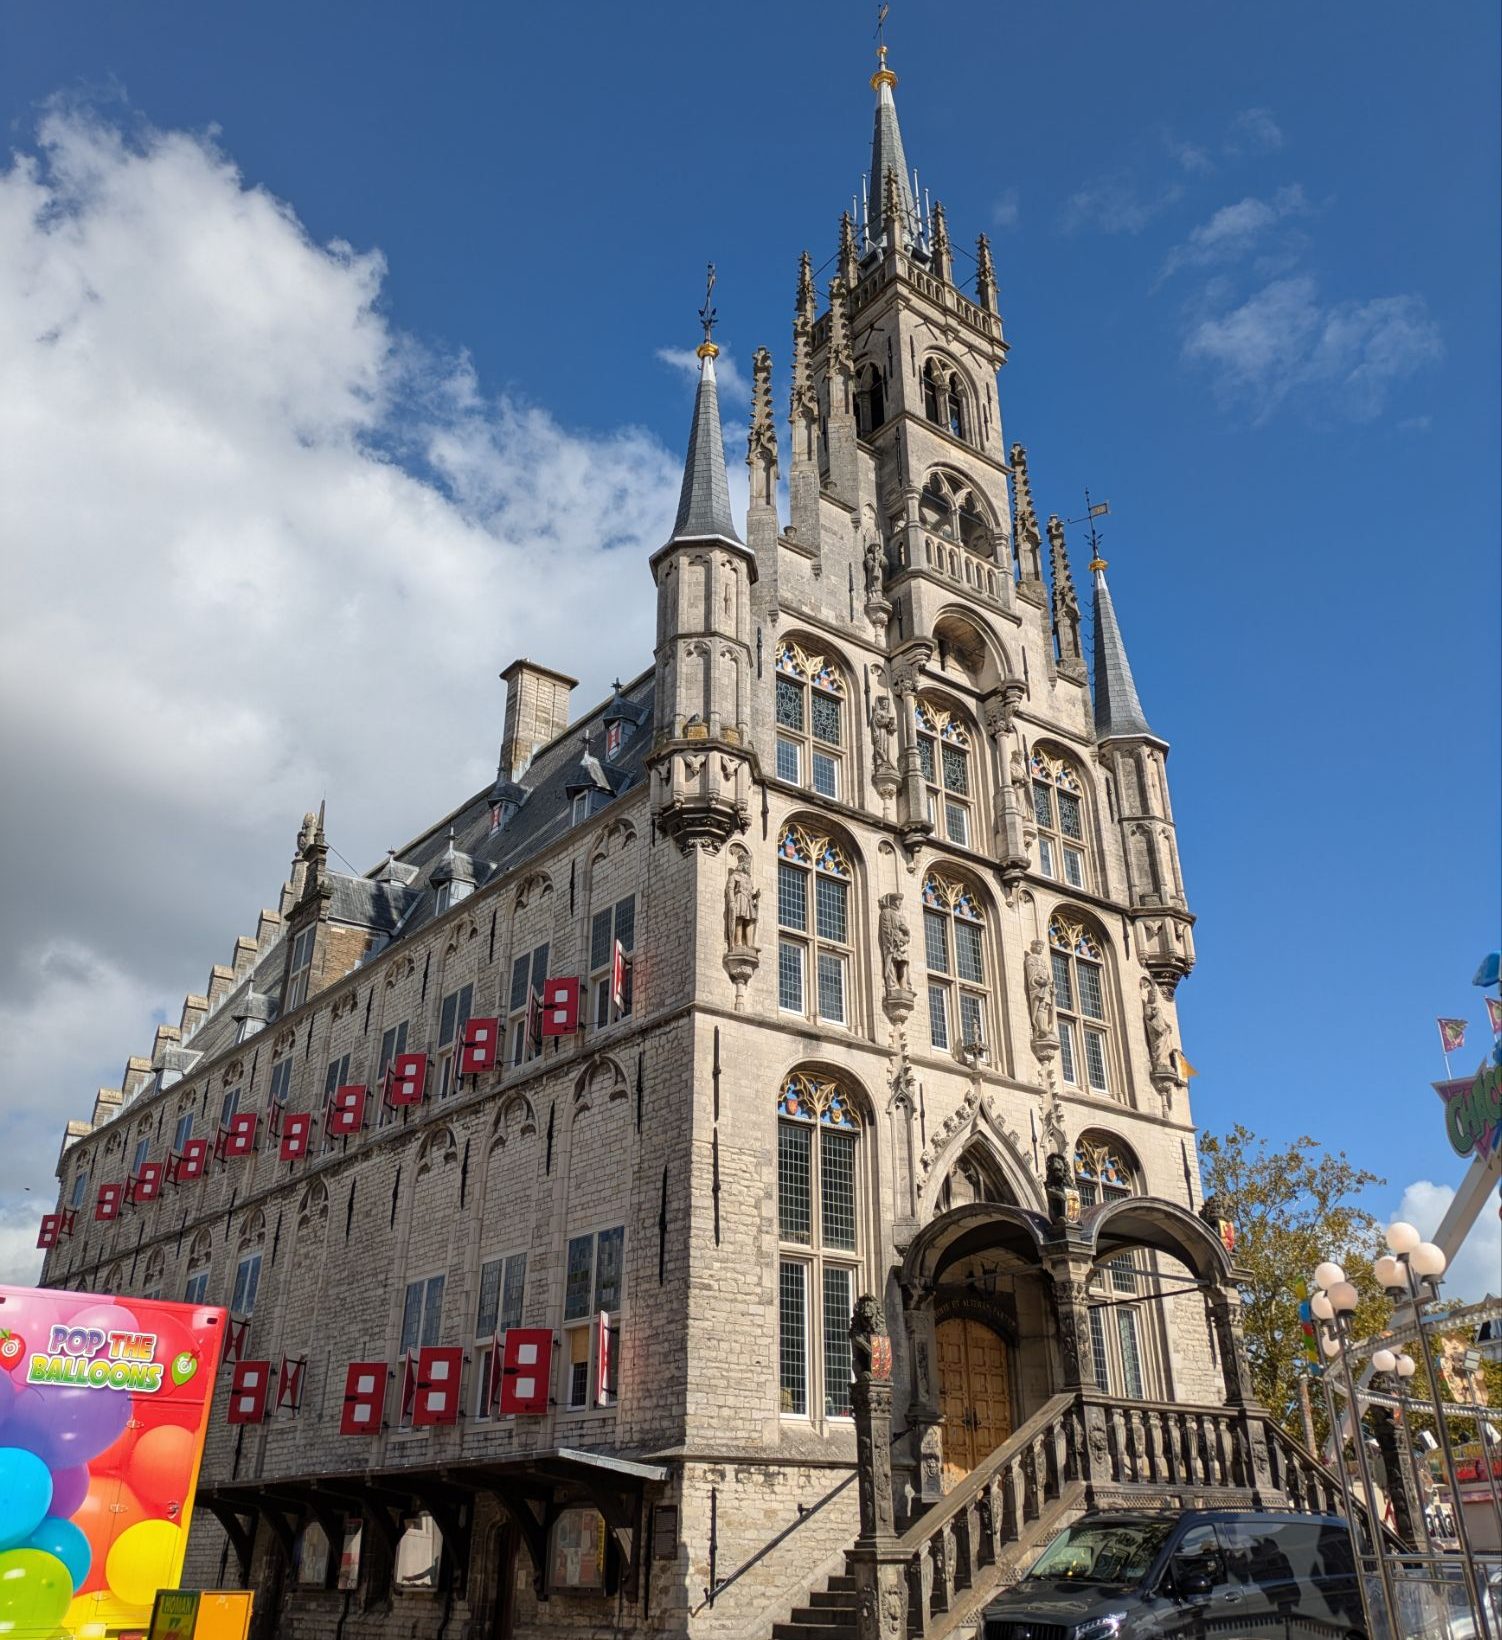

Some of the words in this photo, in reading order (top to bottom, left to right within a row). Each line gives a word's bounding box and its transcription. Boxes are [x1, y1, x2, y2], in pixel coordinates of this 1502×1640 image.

[49, 1325, 104, 1357] POP
[109, 1332, 156, 1361] THE
[28, 1354, 163, 1392] BALLOONS
